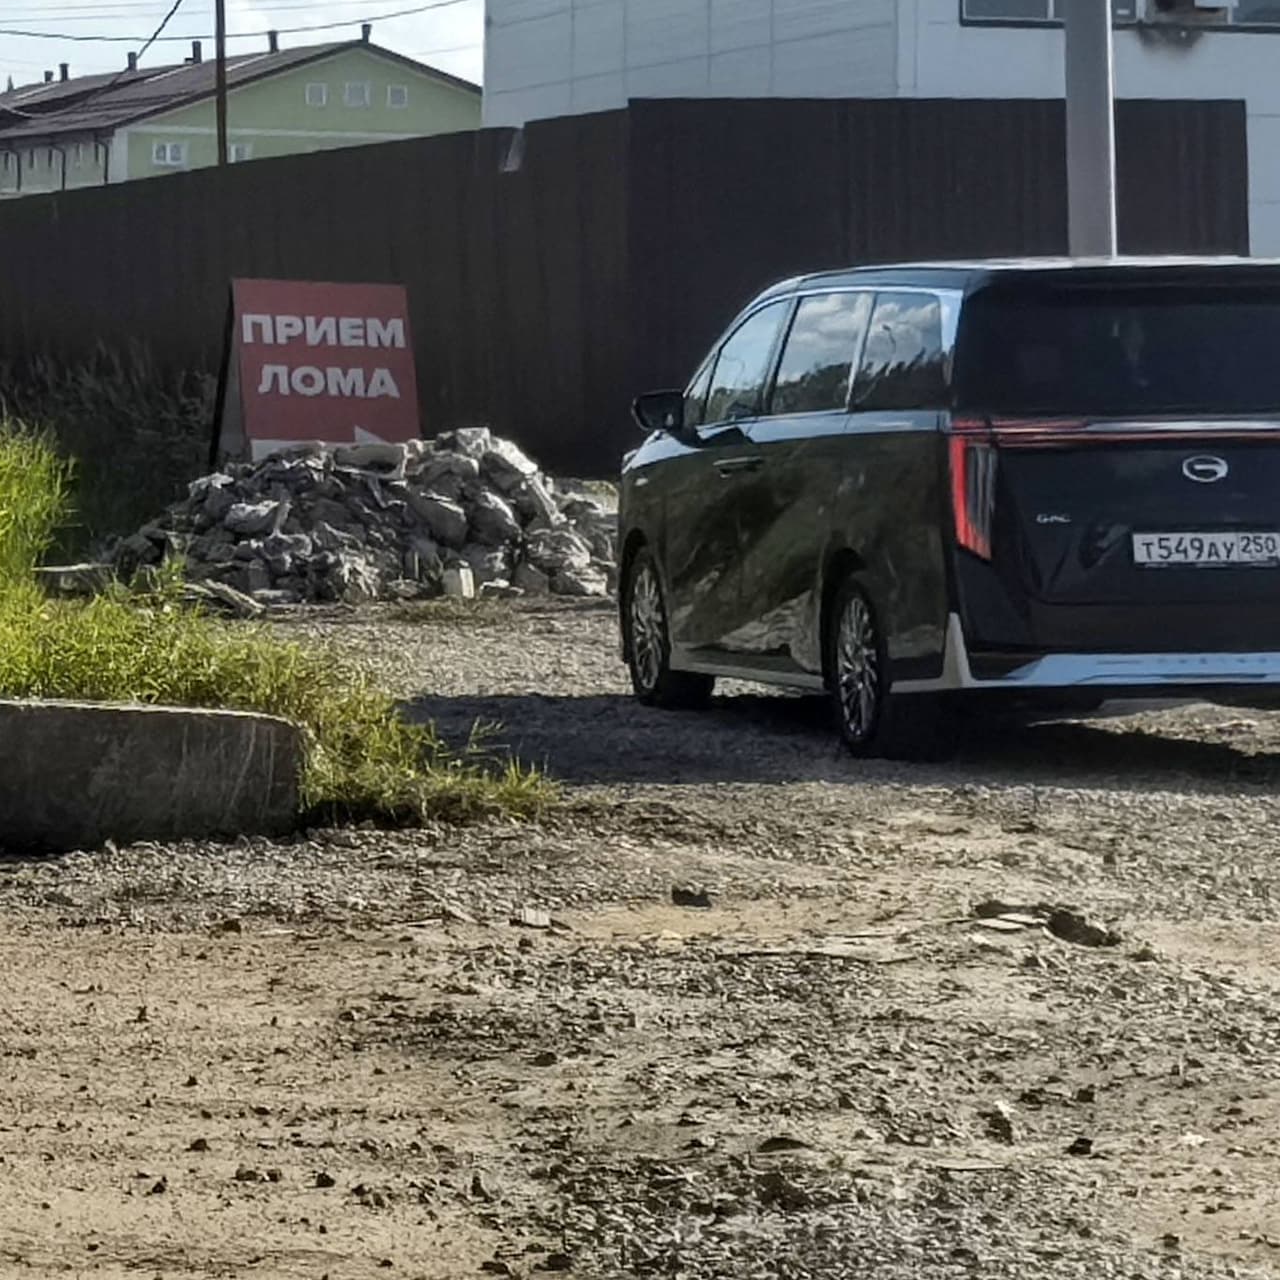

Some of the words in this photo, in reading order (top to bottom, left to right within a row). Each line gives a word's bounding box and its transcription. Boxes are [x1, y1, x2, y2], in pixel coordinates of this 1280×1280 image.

[241, 313, 407, 349] ПРИЕМ
[258, 363, 401, 400] ЛОМА
[1141, 536, 1235, 561] Т549АУ
[1240, 535, 1277, 554] 250
